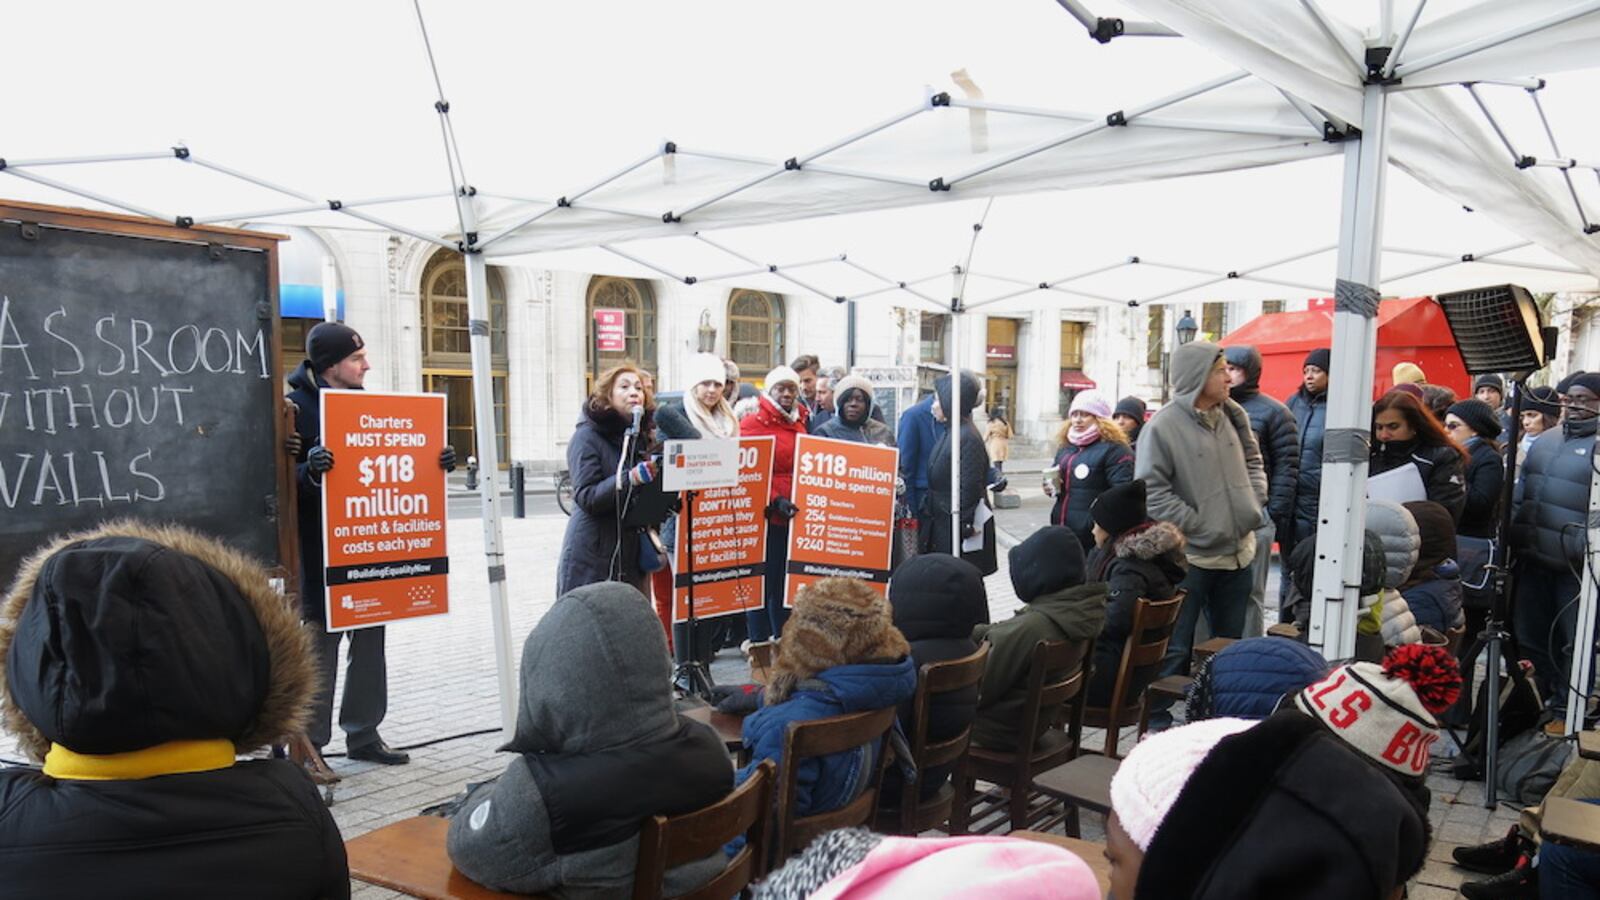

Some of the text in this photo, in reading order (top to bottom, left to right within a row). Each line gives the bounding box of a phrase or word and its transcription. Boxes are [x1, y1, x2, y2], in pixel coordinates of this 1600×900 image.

[0, 296, 270, 380] ASSROOM
[359, 414, 414, 429] Charters
[345, 433, 426, 447] MUST SPEND
[358, 454, 415, 487] $118
[800, 452, 892, 483] $118 million
[799, 474, 891, 496] COULD be spent on:
[345, 487, 429, 518] million
[806, 494, 855, 509] 508 Teachers
[692, 514, 734, 527] programs
[804, 508, 827, 522] 254
[828, 513, 854, 523] Guidance
[334, 518, 442, 537] on rent & facilities
[686, 528, 721, 540] eserve
[803, 523, 825, 537] 127
[343, 537, 433, 554] costs each year
[742, 537, 759, 548] pay
[796, 536, 824, 551] 9240
[695, 553, 709, 565] for
[347, 564, 432, 580] #BuildingEqualityNow
